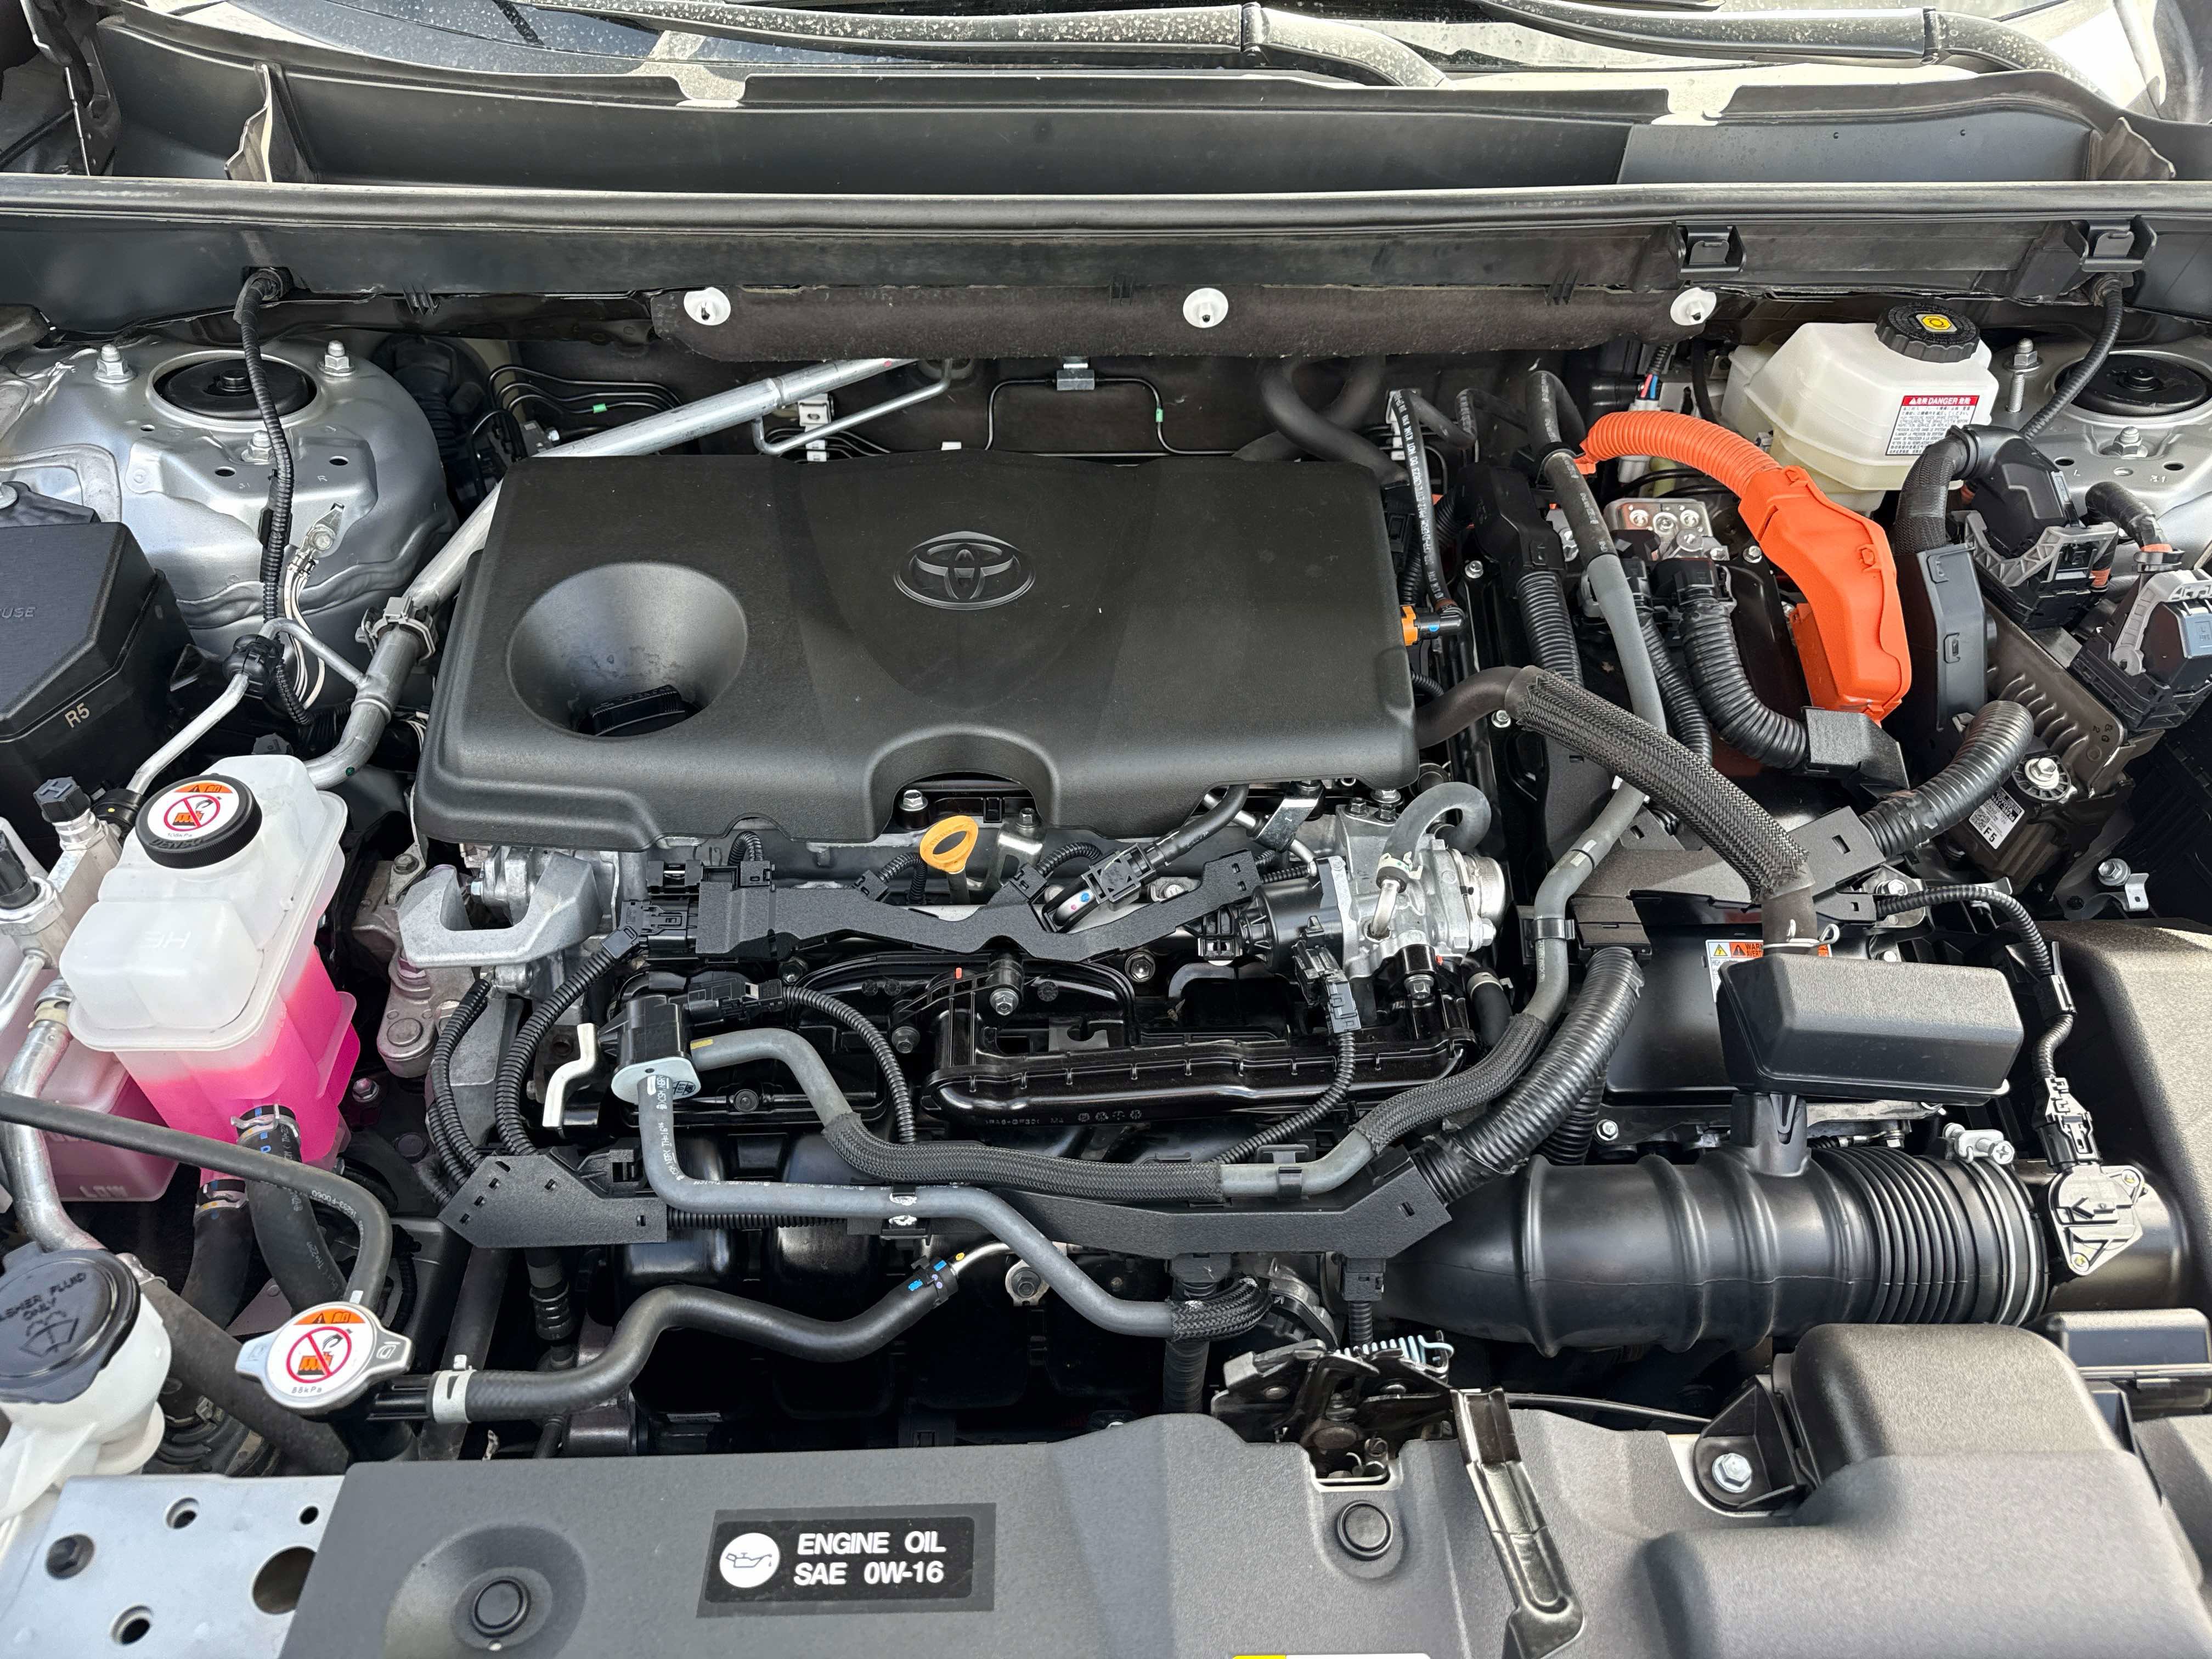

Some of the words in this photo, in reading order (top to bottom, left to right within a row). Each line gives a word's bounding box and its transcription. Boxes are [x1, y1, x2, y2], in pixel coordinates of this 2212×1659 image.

[0, 606, 37, 619] USE
[64, 702, 90, 729] R5
[39, 781, 73, 799] H
[1995, 793, 2013, 813] TOYOTA
[149, 838, 204, 849] DENSO
[78, 1185, 128, 1198] LOW
[49, 1272, 87, 1295] FLUID
[22, 1297, 57, 1321] ONLY
[291, 1386, 323, 1394] 88kPa
[797, 1531, 890, 1556] ENGINE
[904, 1530, 947, 1554] OIL
[793, 1562, 848, 1587] SAE
[864, 1560, 944, 1585] 0W-16
